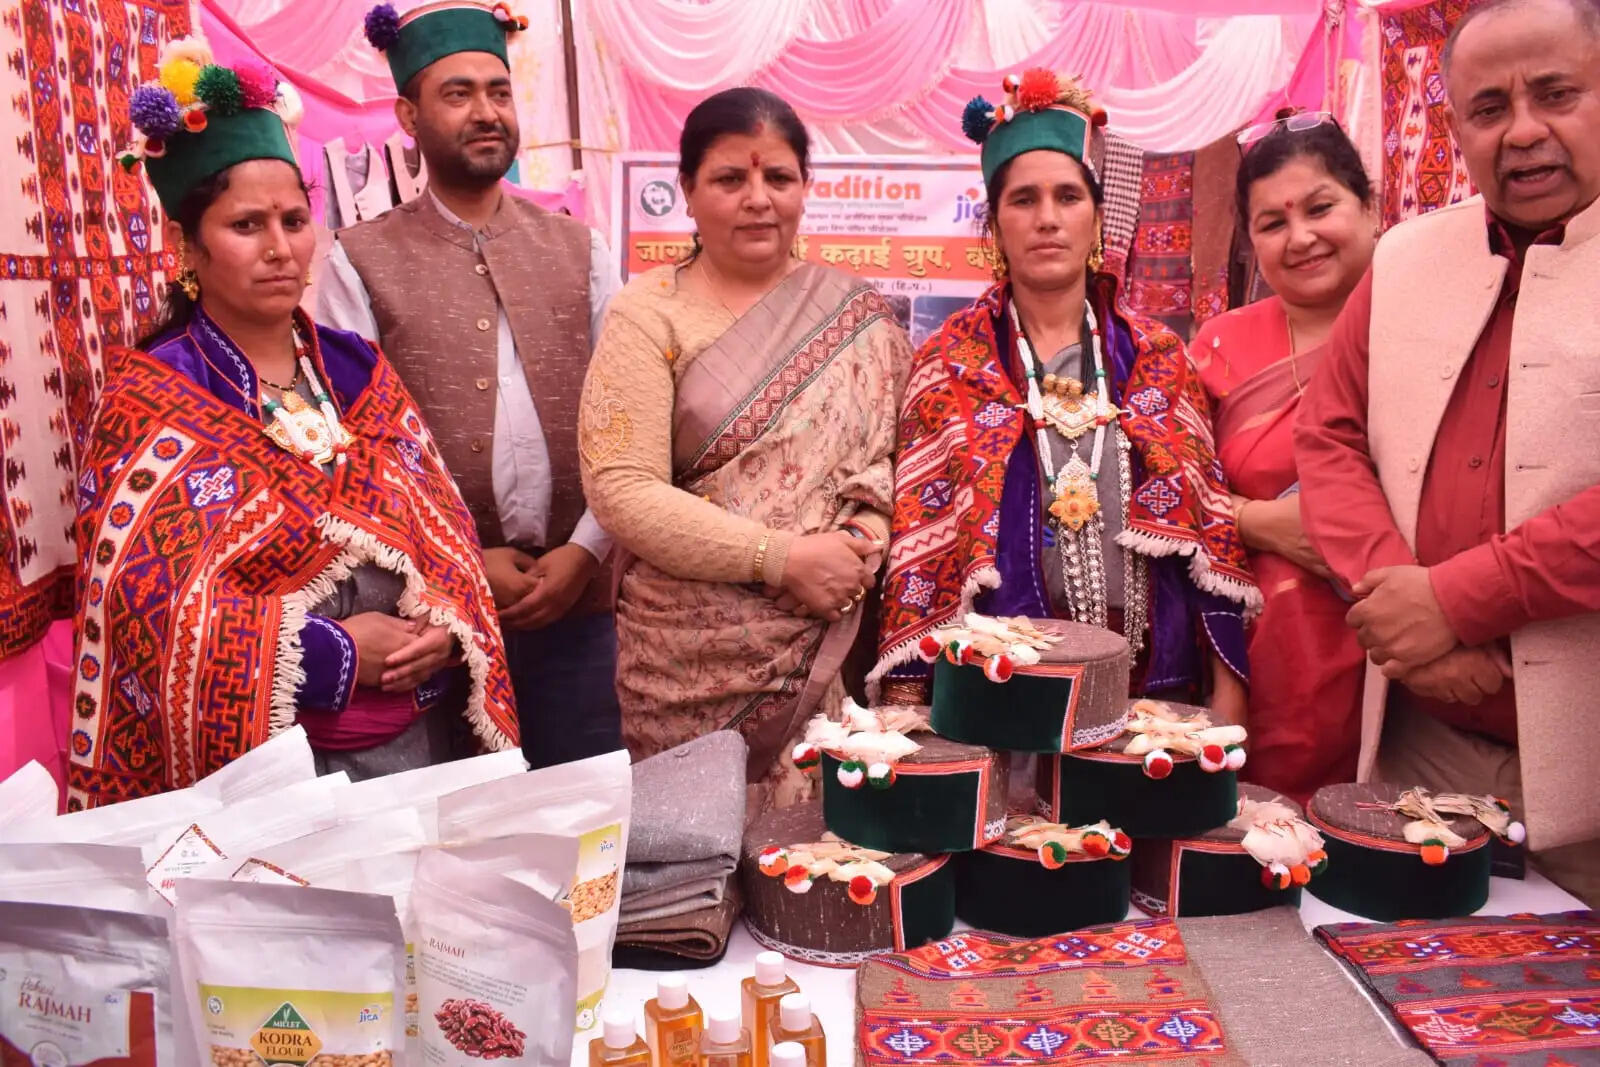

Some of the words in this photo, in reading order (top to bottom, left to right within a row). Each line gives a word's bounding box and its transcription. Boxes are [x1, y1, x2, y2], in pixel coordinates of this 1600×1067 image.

[18, 991, 92, 1024] RAJMAH
[259, 1031, 313, 1047] KODRA
[265, 1045, 305, 1057] FLOUR
